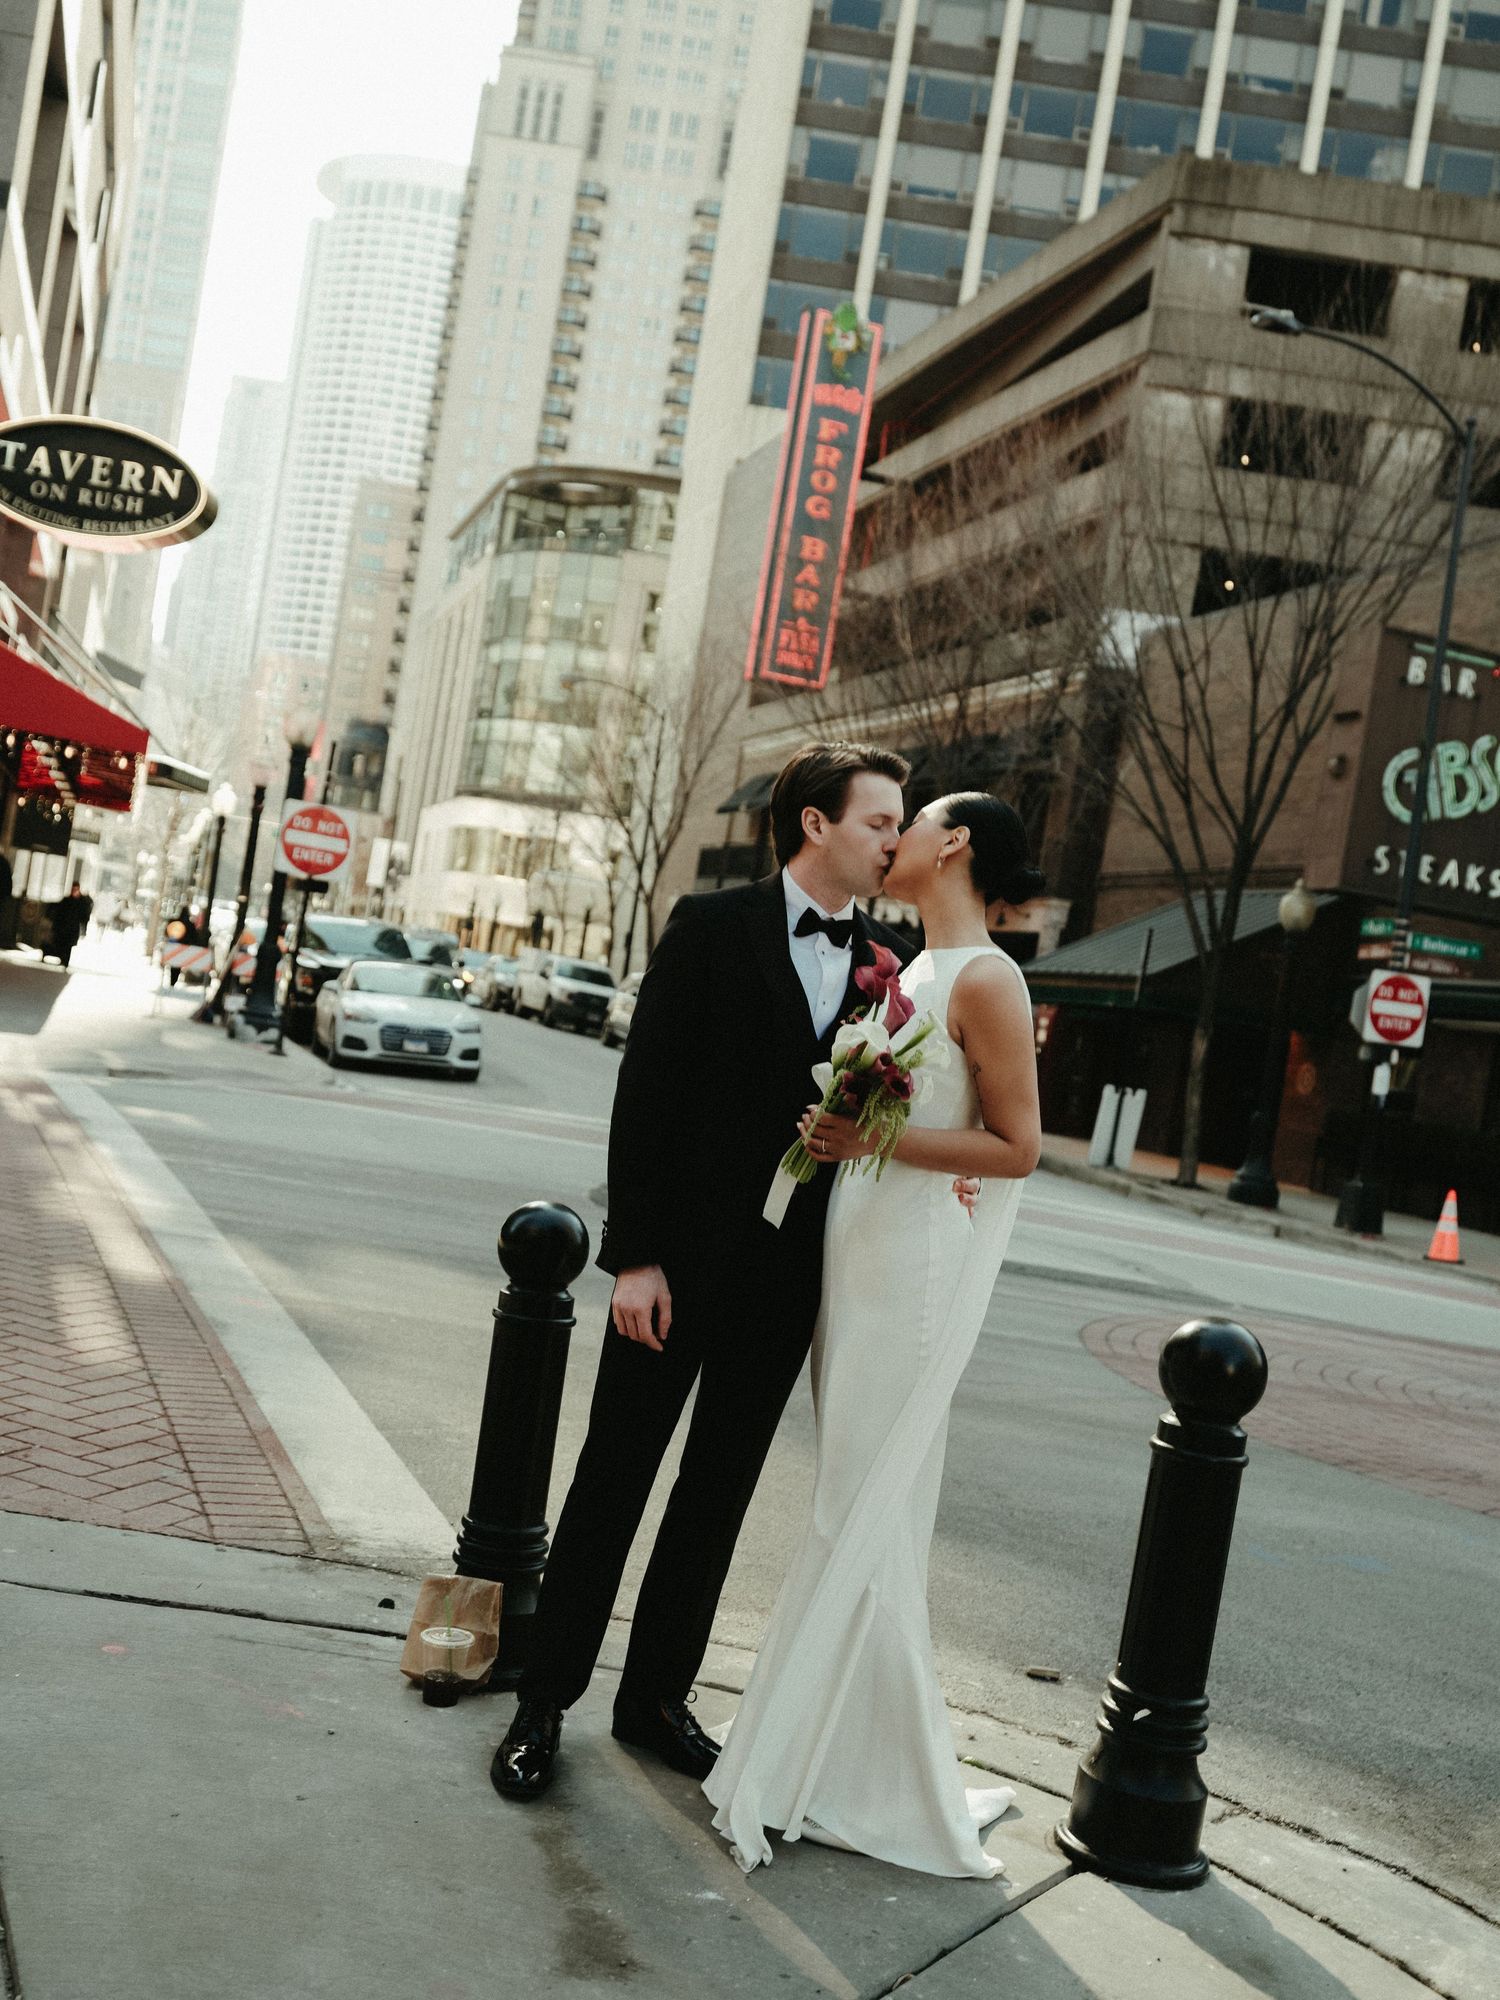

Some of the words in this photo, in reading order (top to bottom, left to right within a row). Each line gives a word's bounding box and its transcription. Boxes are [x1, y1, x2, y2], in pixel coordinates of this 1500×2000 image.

[0, 439, 184, 500] TAVERN
[804, 417, 849, 520] FROG
[30, 480, 68, 501] ON
[78, 487, 144, 515] RUSH
[793, 534, 829, 613] BAR
[1382, 735, 1500, 824] GIBS
[292, 815, 312, 830] DO
[317, 821, 344, 837] NOT
[292, 847, 334, 865] ENTER
[1378, 985, 1394, 999] DO
[1398, 987, 1419, 1002] NOT
[1377, 1016, 1412, 1032] ENTER
